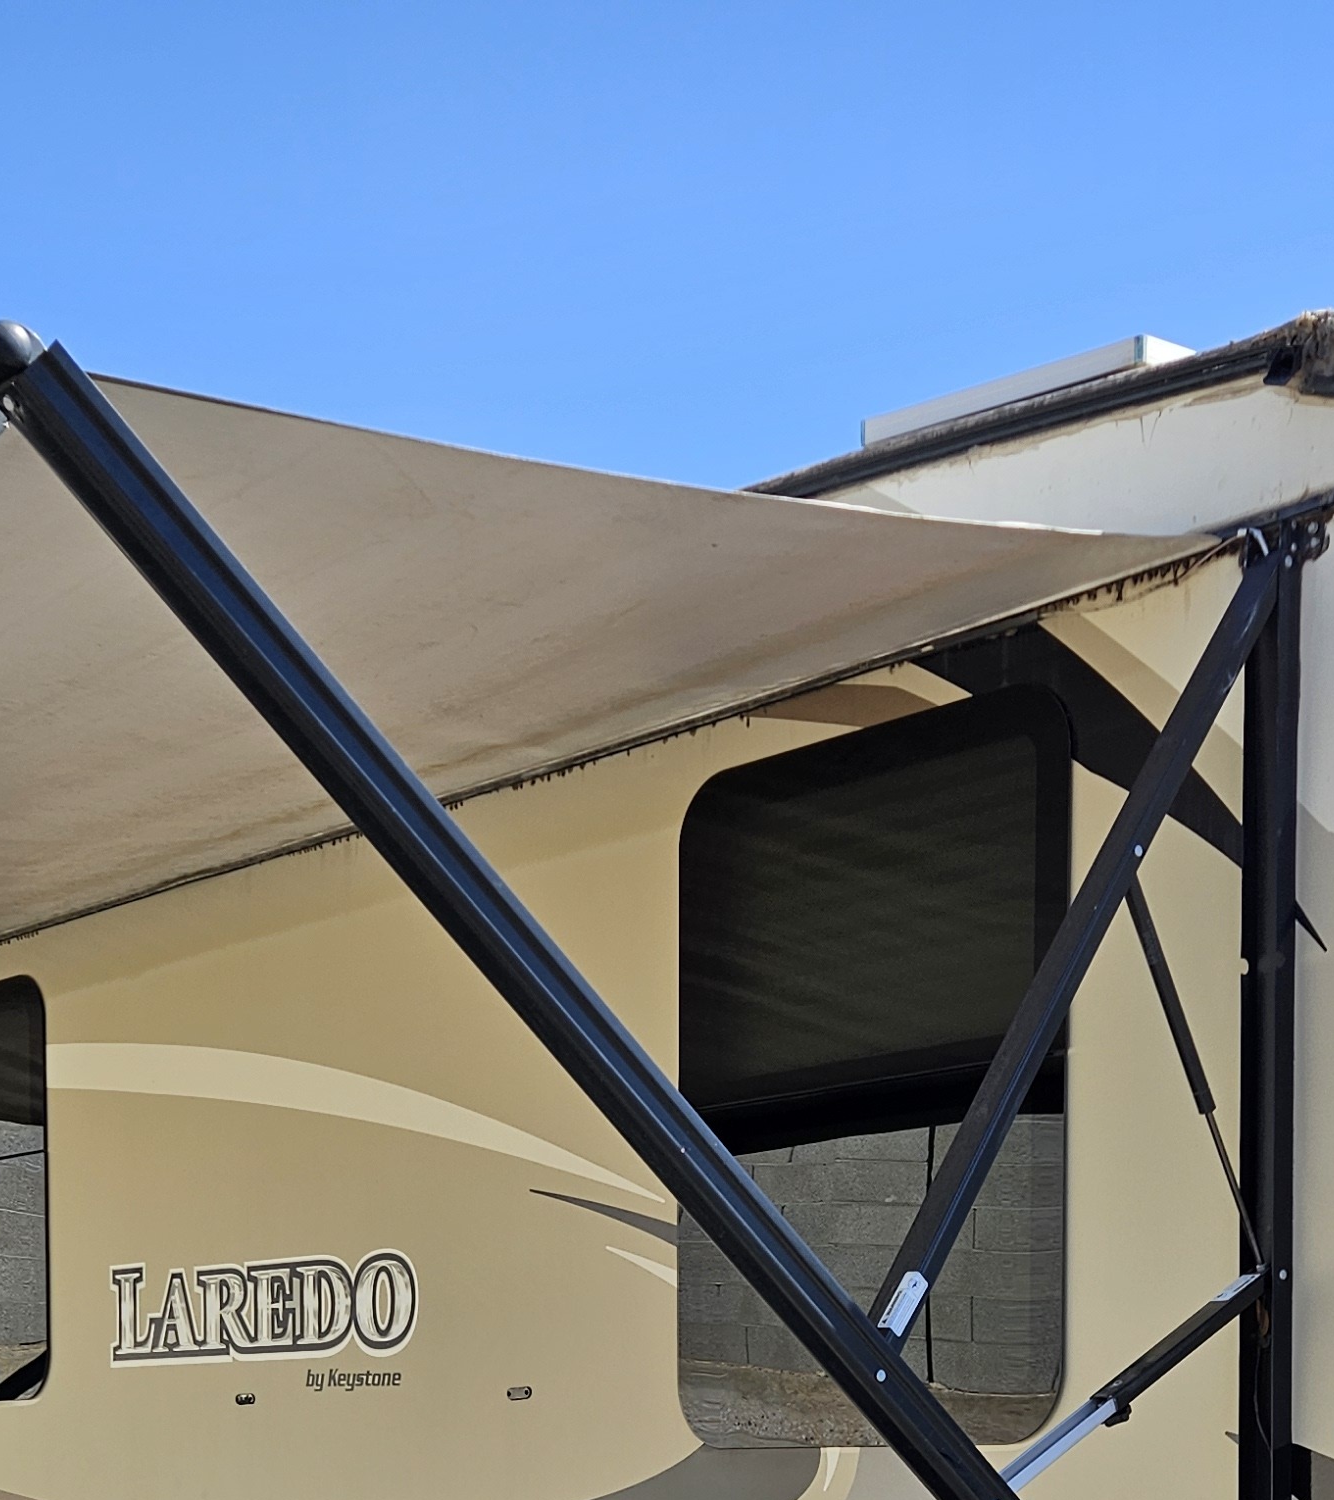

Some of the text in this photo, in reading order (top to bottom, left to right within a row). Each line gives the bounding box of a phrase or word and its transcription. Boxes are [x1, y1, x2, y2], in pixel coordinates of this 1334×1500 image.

[110, 1249, 418, 1367] LAREDO
[306, 1368, 402, 1392] by Keystone
